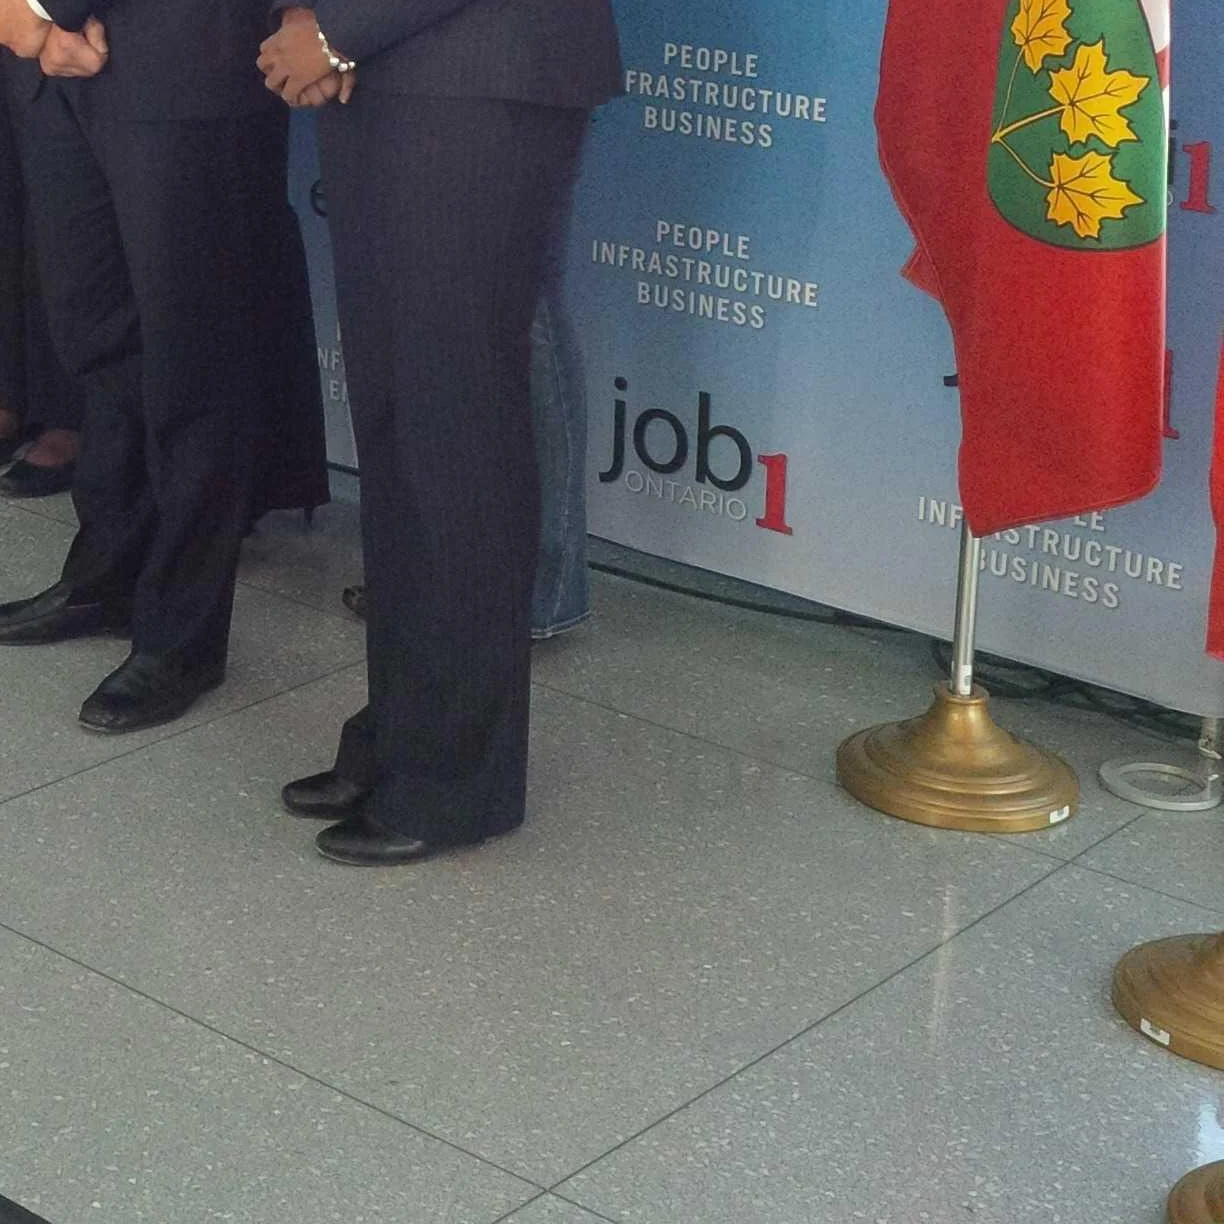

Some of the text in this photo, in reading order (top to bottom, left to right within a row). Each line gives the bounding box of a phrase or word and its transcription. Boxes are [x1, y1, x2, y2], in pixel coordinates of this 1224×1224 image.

[664, 42, 759, 79] PEOPLE
[626, 69, 828, 123] FRASTRUCTURE
[644, 105, 773, 148] BUSINESS
[656, 219, 751, 260] PEOPLE
[591, 239, 818, 308] INFRASTRUCTURE
[636, 280, 765, 329] BUSINESS
[625, 470, 747, 520] ONTARIO
